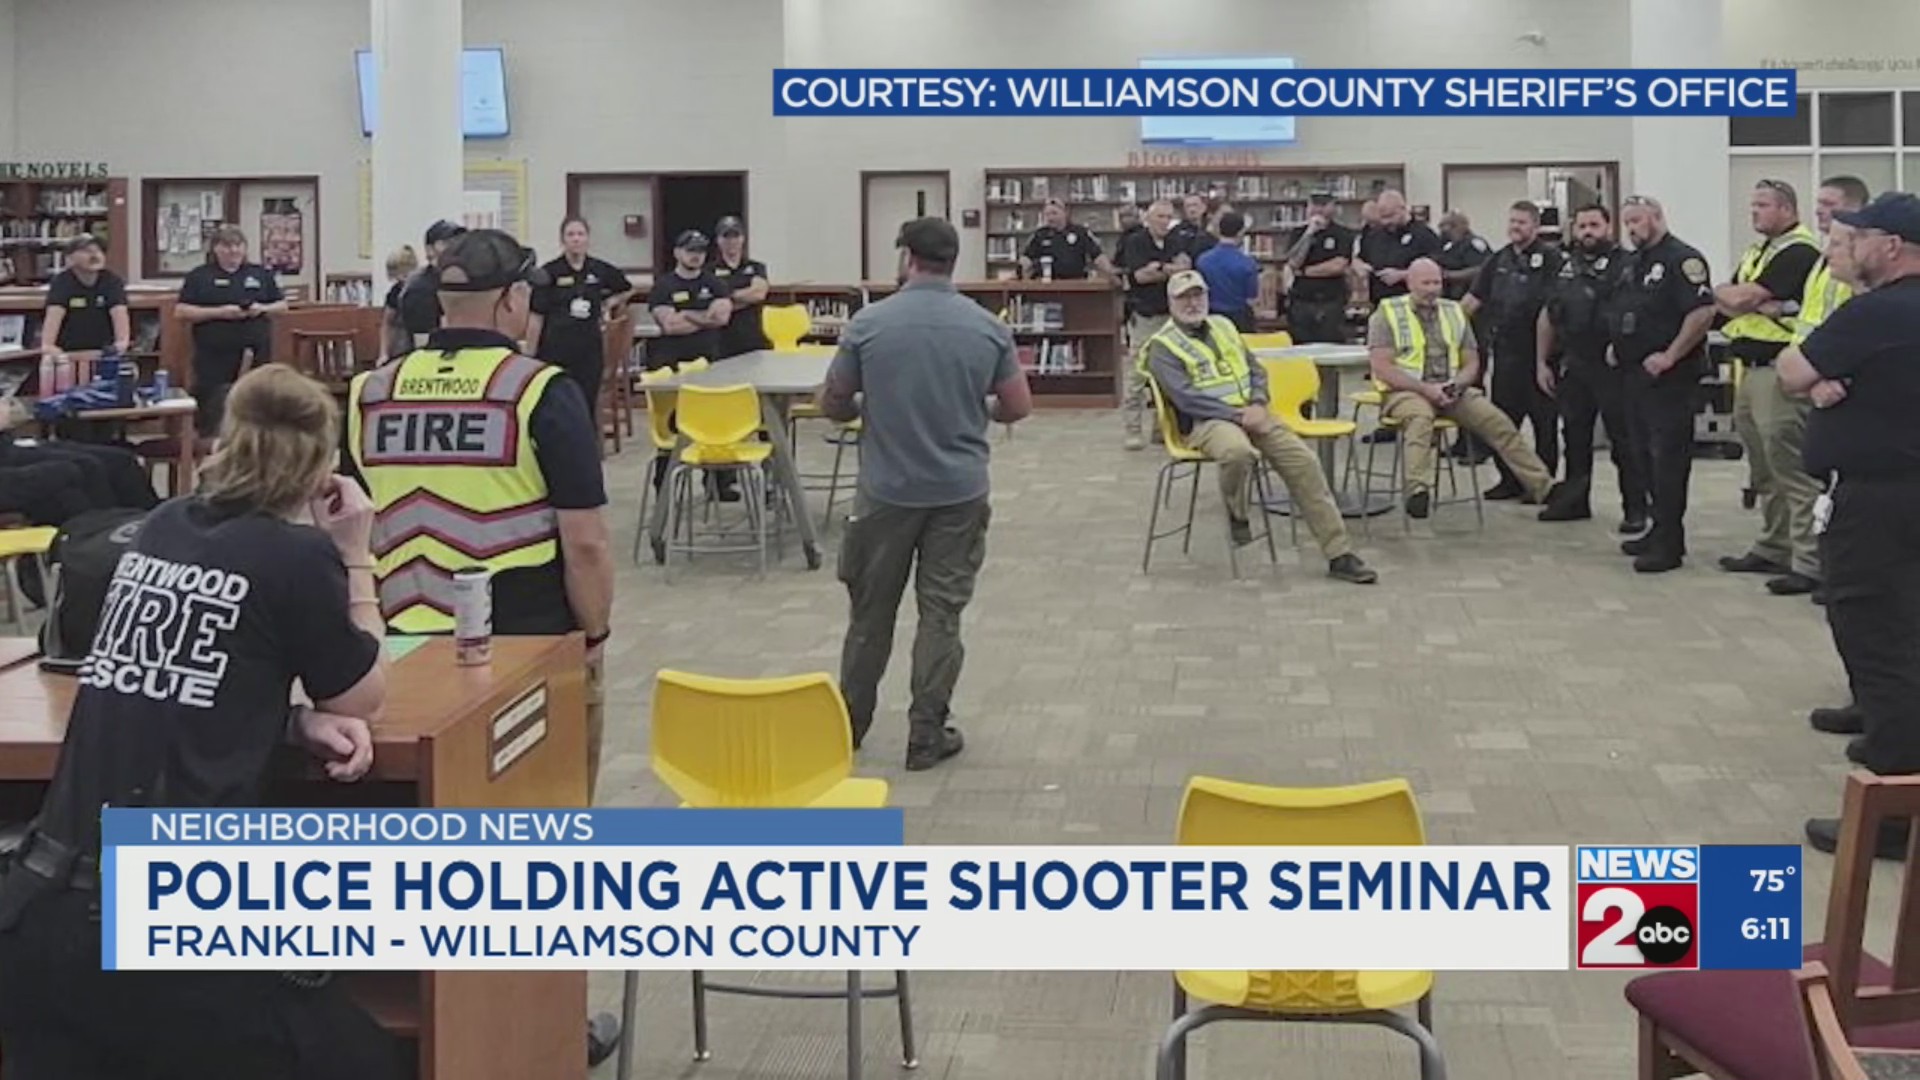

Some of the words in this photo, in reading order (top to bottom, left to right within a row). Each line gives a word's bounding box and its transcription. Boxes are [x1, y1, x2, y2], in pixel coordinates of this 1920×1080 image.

[26, 162, 109, 179] NOVELS
[400, 378, 480, 395] BRENTWOOD
[376, 412, 488, 453] FIRE
[77, 654, 220, 708] ESCUE
